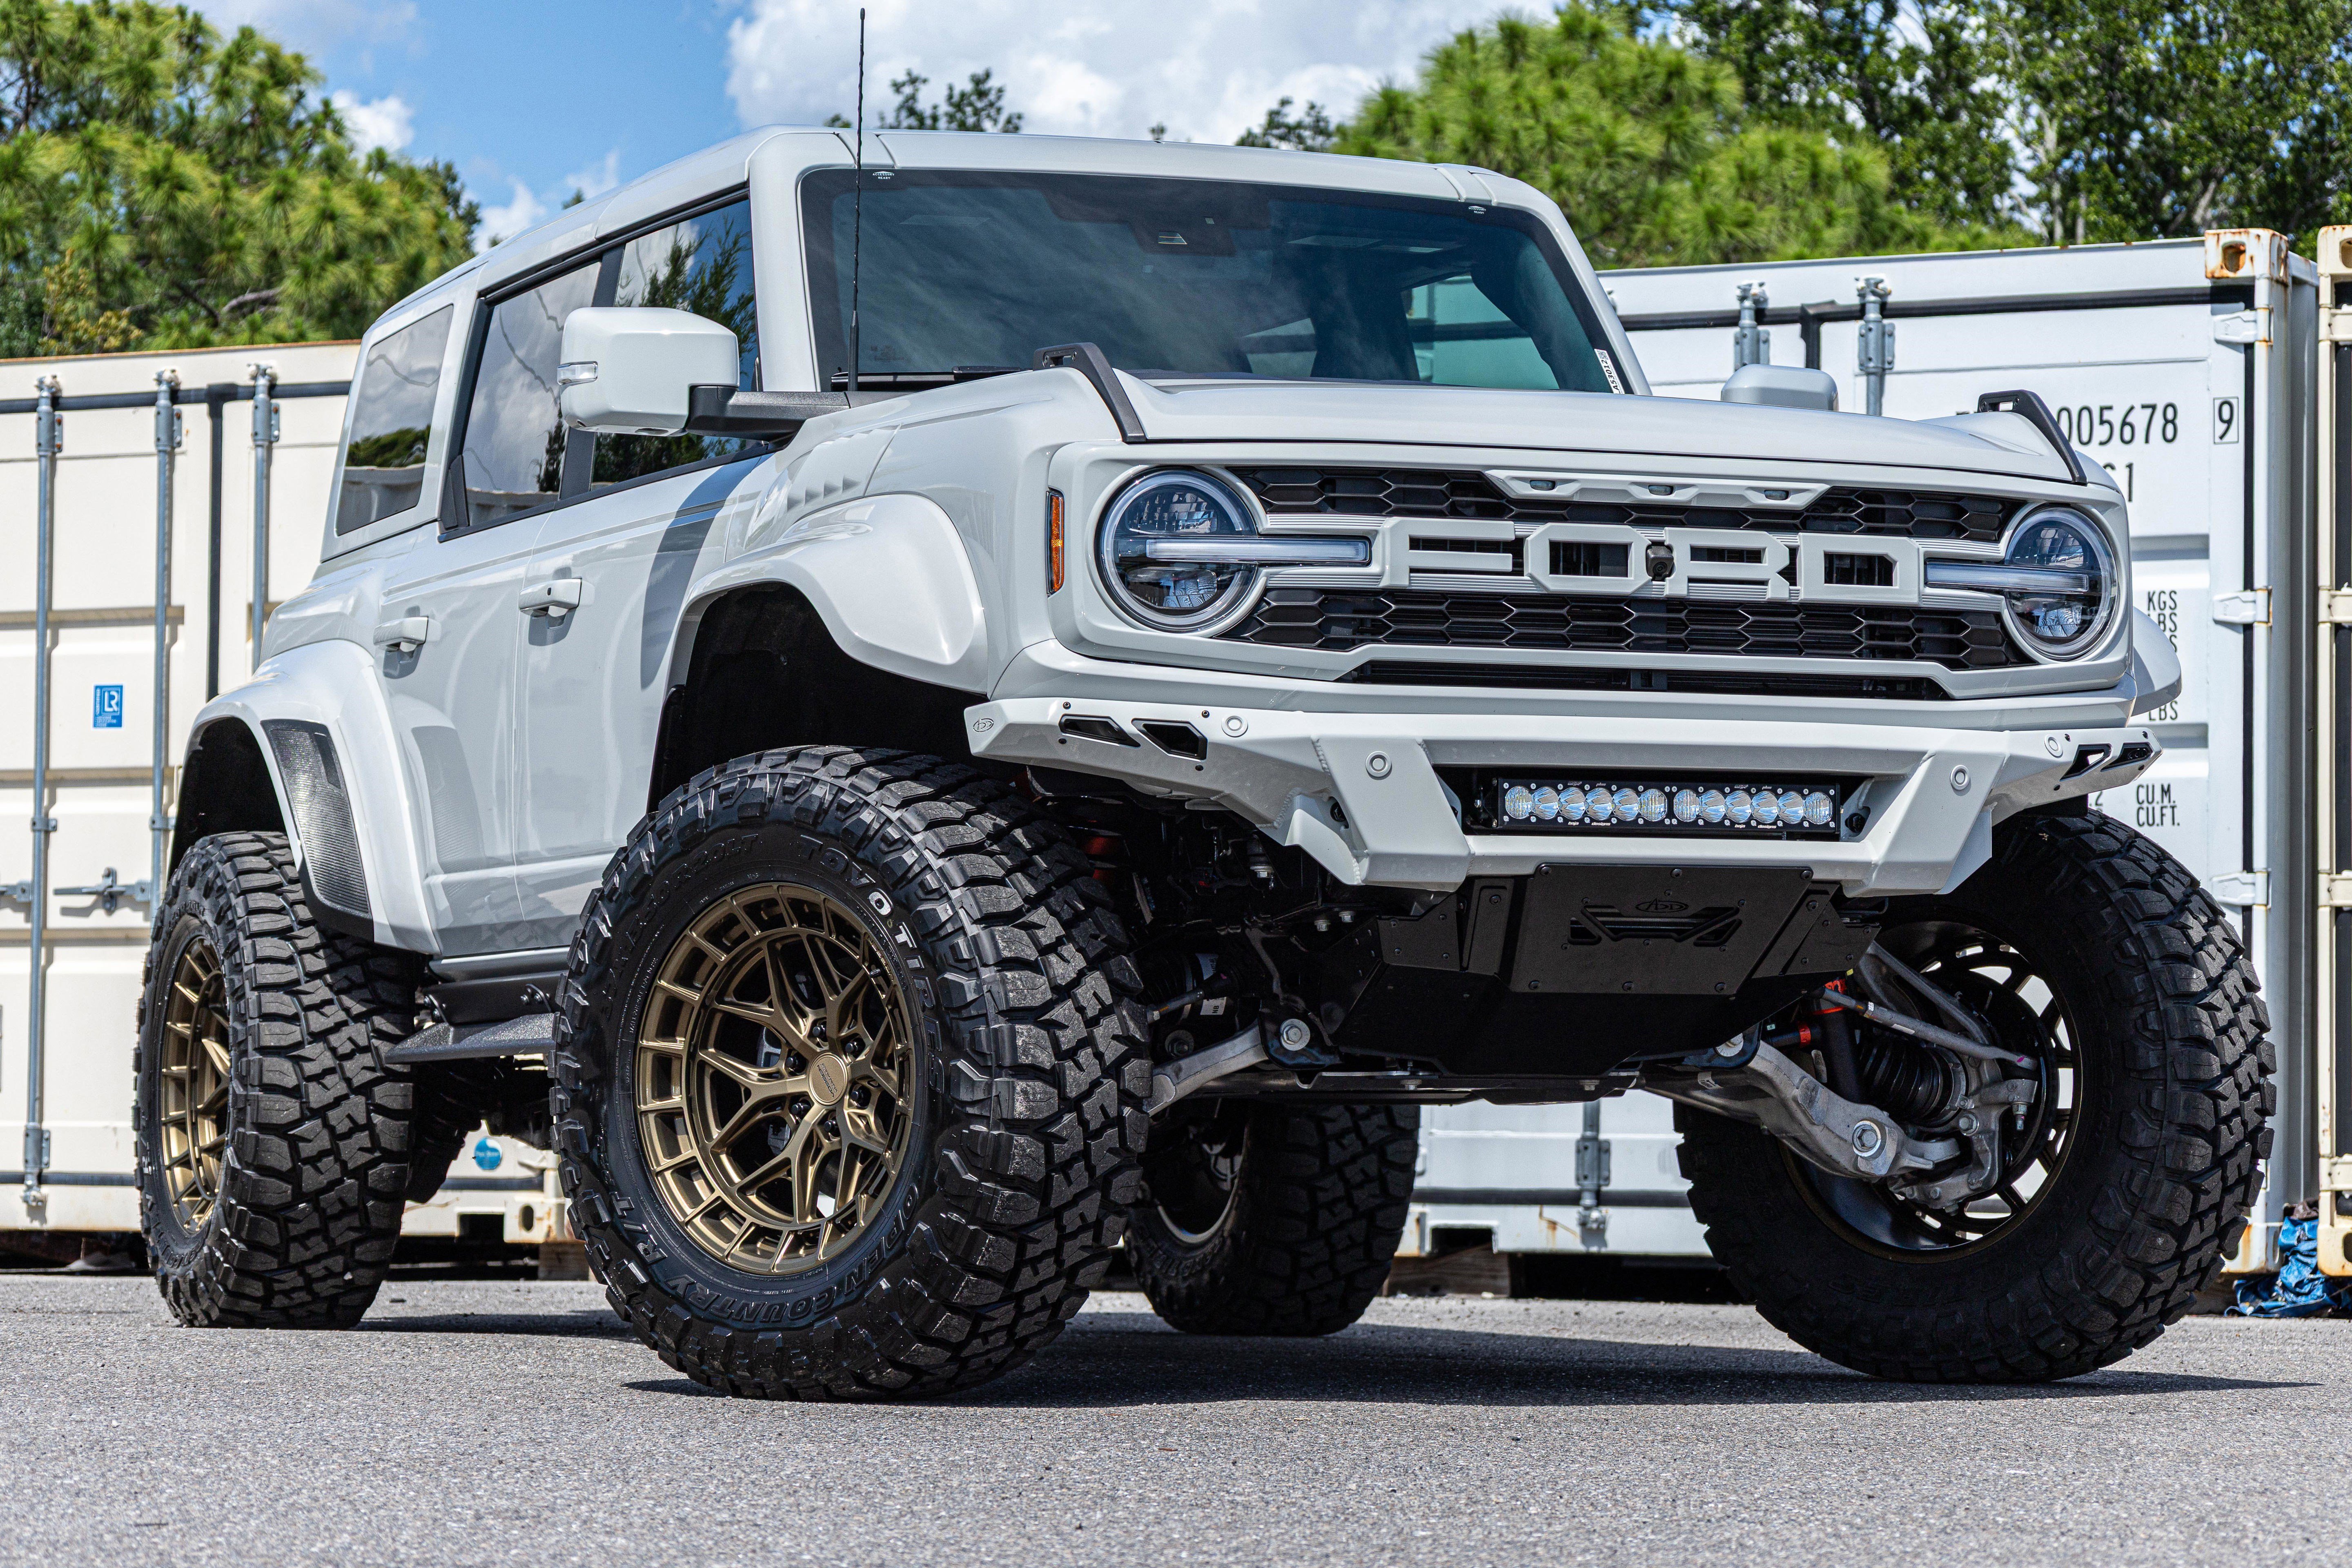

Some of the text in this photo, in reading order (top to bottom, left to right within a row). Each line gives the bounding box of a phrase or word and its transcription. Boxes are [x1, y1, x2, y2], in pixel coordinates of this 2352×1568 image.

[1601, 359, 1621, 394] A53012
[2218, 400, 2234, 440] 9
[1379, 516, 1922, 606] FORD
[2147, 590, 2177, 610] KGS
[2147, 613, 2178, 632] BS
[104, 691, 120, 712] LR
[2136, 783, 2176, 804] CU.M.
[2137, 805, 2180, 827] CU.FT.
[799, 834, 894, 918] TOYO
[894, 921, 945, 1094] TIRES
[610, 1192, 668, 1264] R/T
[844, 1183, 919, 1296] OPEN
[664, 1274, 837, 1323] COUNTRY
